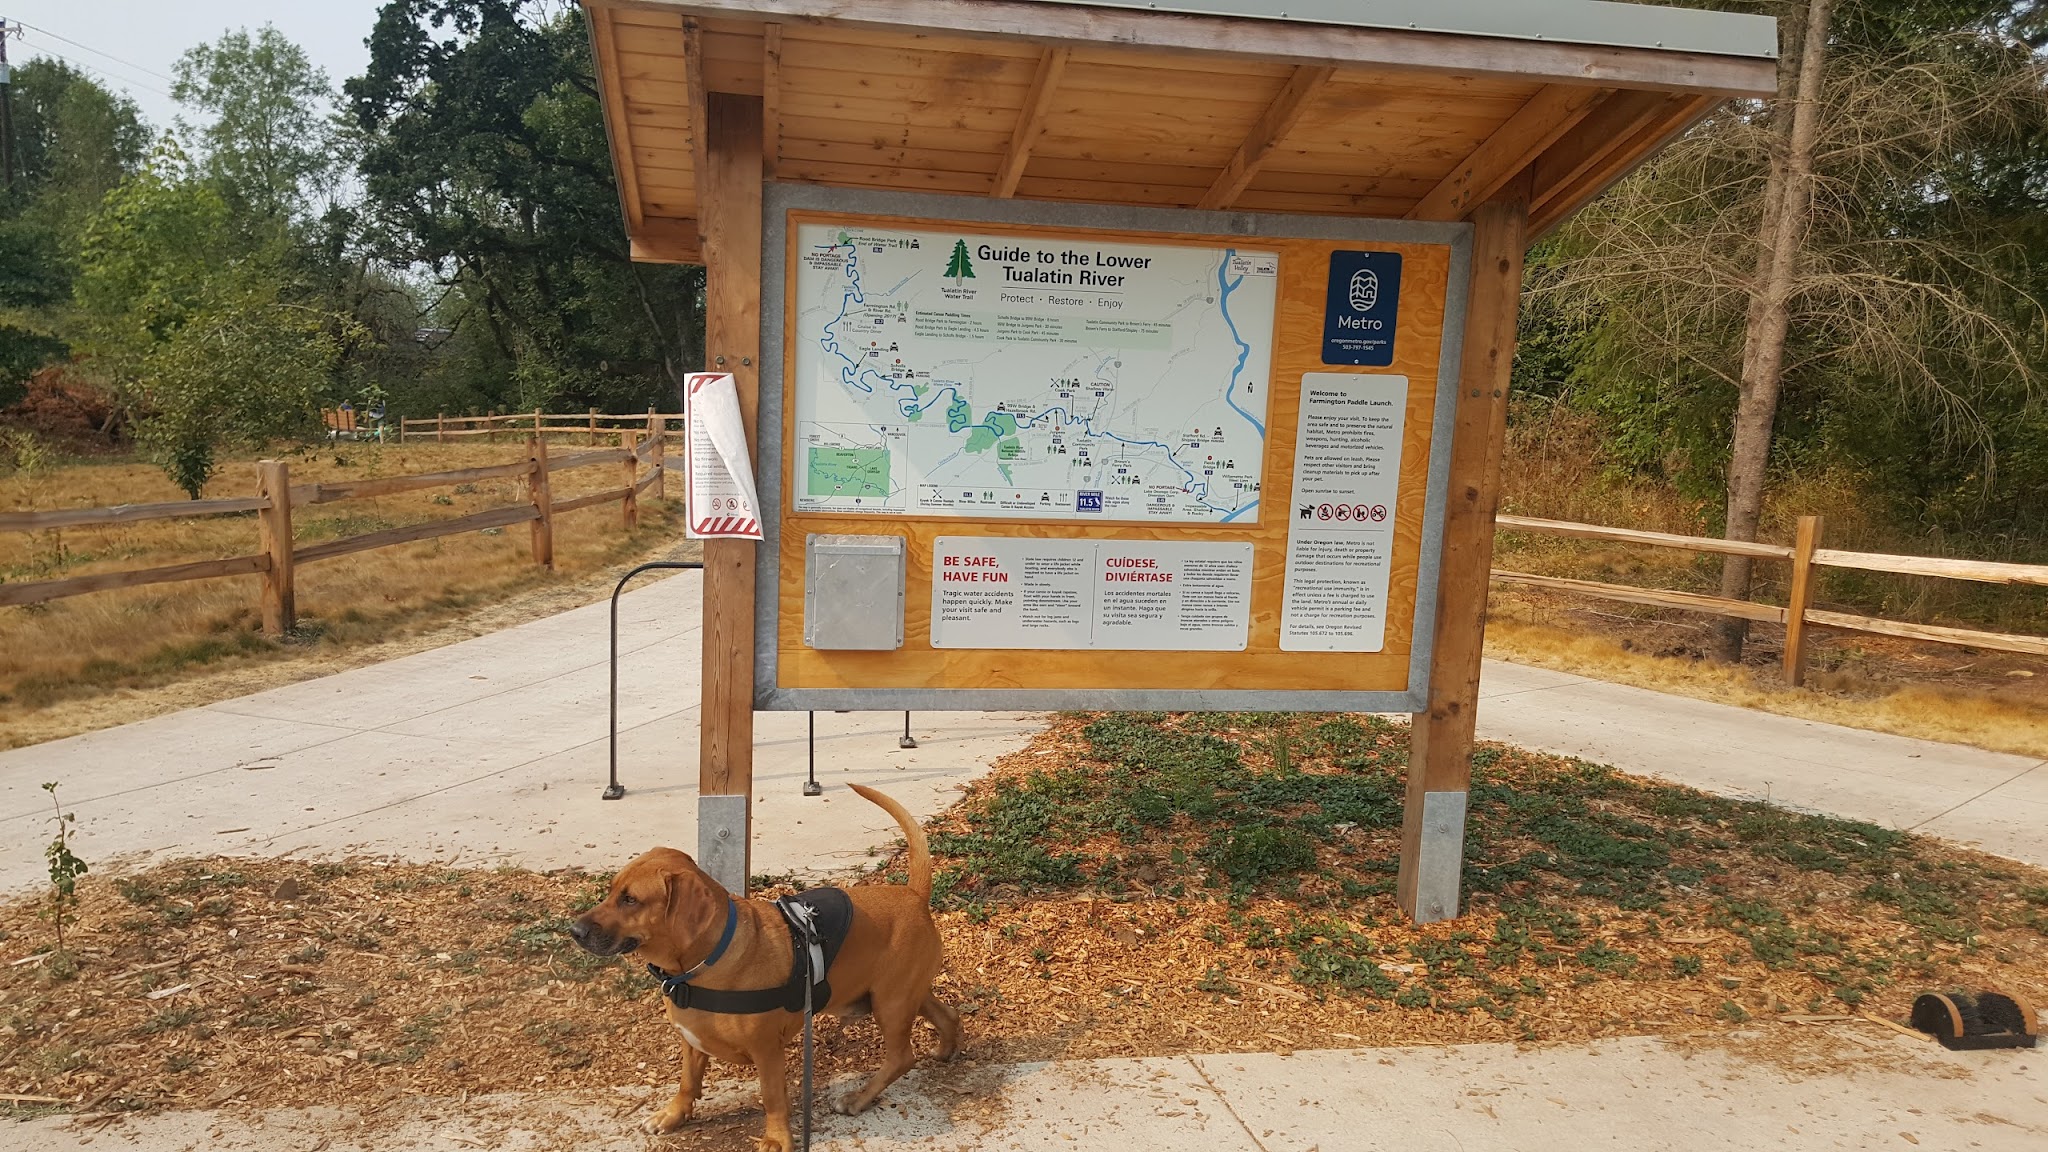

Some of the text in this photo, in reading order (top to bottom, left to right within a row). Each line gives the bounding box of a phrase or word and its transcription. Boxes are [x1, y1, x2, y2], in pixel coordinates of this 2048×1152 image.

[978, 245, 1151, 269] Guide to the Lower
[1002, 266, 1124, 287] Tualatin River
[1001, 293, 1123, 310] Protect Restore Enjoy
[1338, 315, 1383, 330] Metro
[1309, 398, 1346, 406] Farmington
[1079, 498, 1093, 507] 11.5
[944, 556, 999, 568] BE SAFE,
[1106, 557, 1158, 569] CUÍDESE,
[943, 572, 1008, 582] HAVE FUN
[1106, 571, 1172, 582] DIVIÉRTASE
